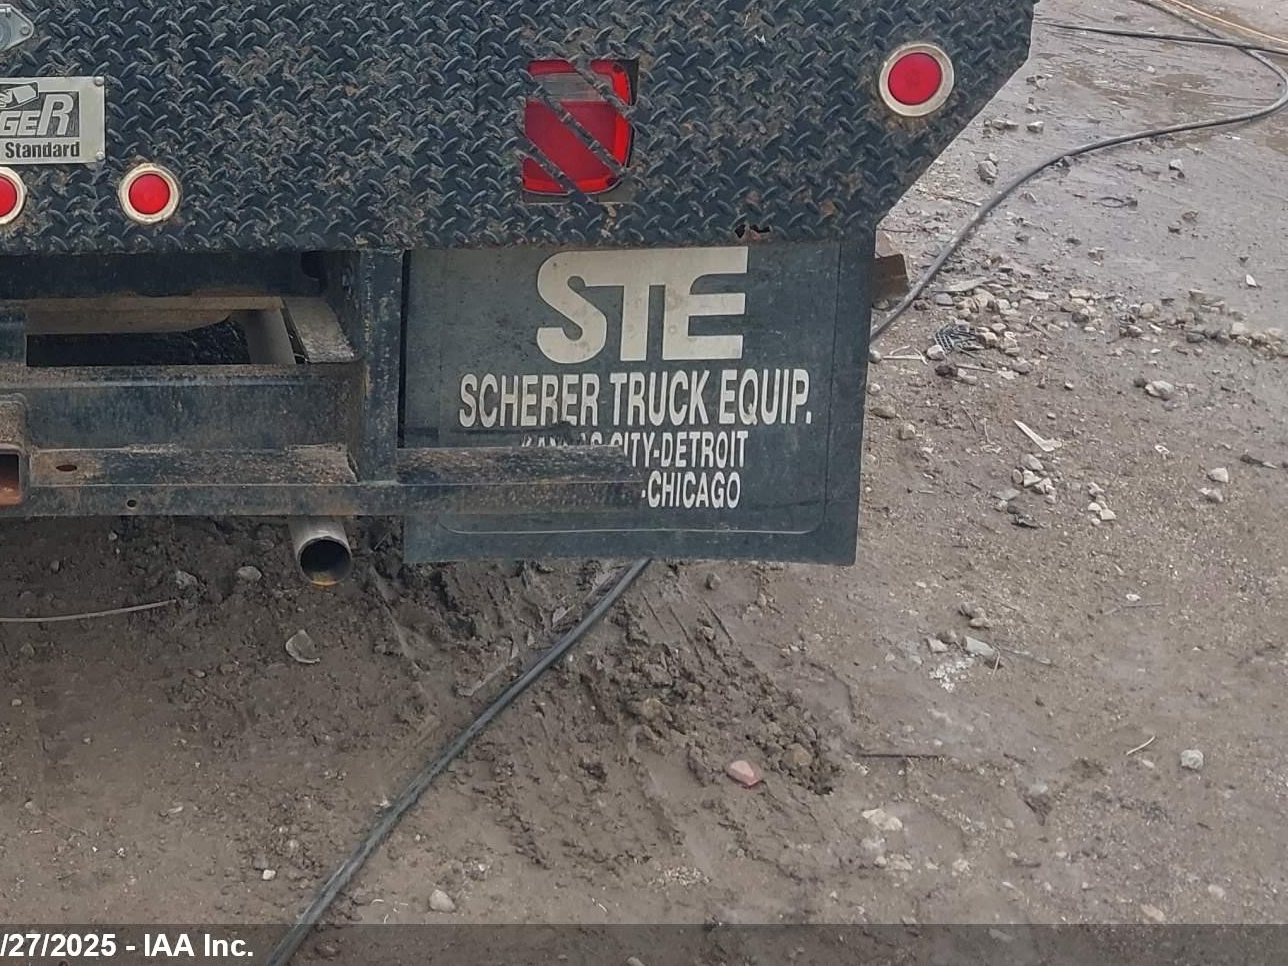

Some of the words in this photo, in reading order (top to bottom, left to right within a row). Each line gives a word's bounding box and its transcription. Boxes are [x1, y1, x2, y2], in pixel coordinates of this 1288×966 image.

[5, 140, 80, 158] Standard
[537, 246, 749, 364] STE
[459, 373, 601, 428] SCHERER
[609, 369, 711, 427] TRUCK
[718, 368, 813, 426] EQUIP.
